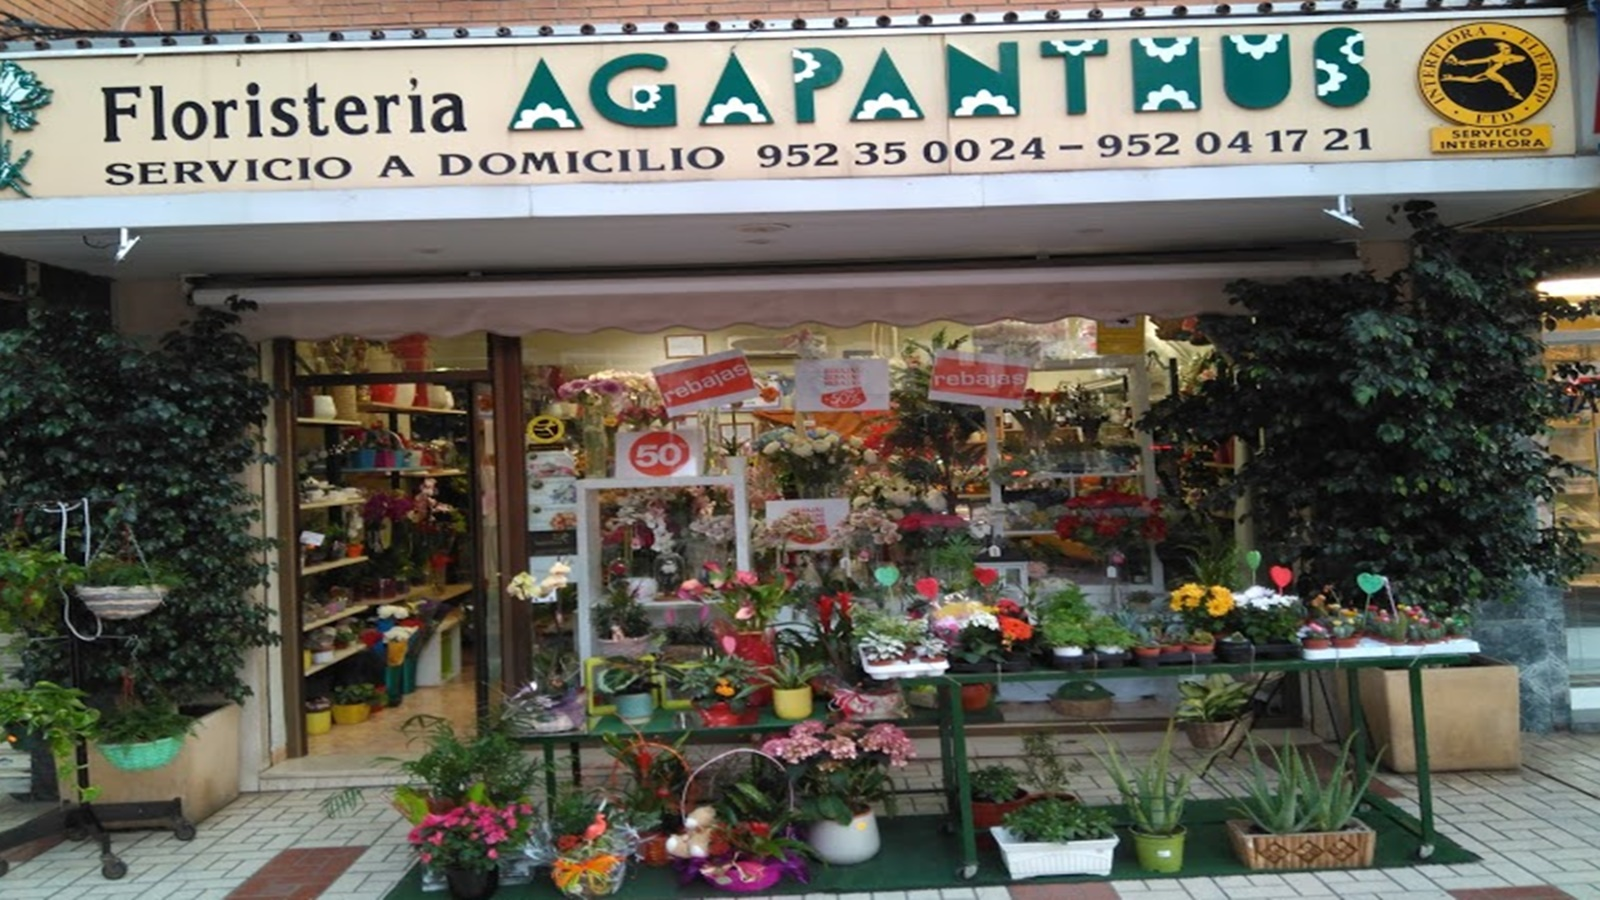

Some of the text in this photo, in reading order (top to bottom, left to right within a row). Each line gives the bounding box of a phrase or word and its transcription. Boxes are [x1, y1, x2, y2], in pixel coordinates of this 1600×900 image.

[508, 27, 1371, 131] AGAPANTHUS
[1422, 26, 1488, 105] INTERFLORA
[1518, 36, 1553, 104] FLEUROP
[1452, 127, 1533, 139] SERVICIO
[1475, 111, 1515, 125] FTD
[757, 143, 838, 168] 952
[855, 142, 906, 166] 35
[1097, 132, 1180, 158] 952
[1196, 131, 1253, 155] 04
[1266, 129, 1309, 153] 17
[1323, 128, 1372, 152] 21
[1440, 138, 1546, 150] INTERFLORA
[106, 146, 724, 186] SERVICIO A DOMICILIO
[663, 363, 749, 404] rebajas
[933, 369, 1026, 391] rebajas
[635, 443, 683, 469] 50
